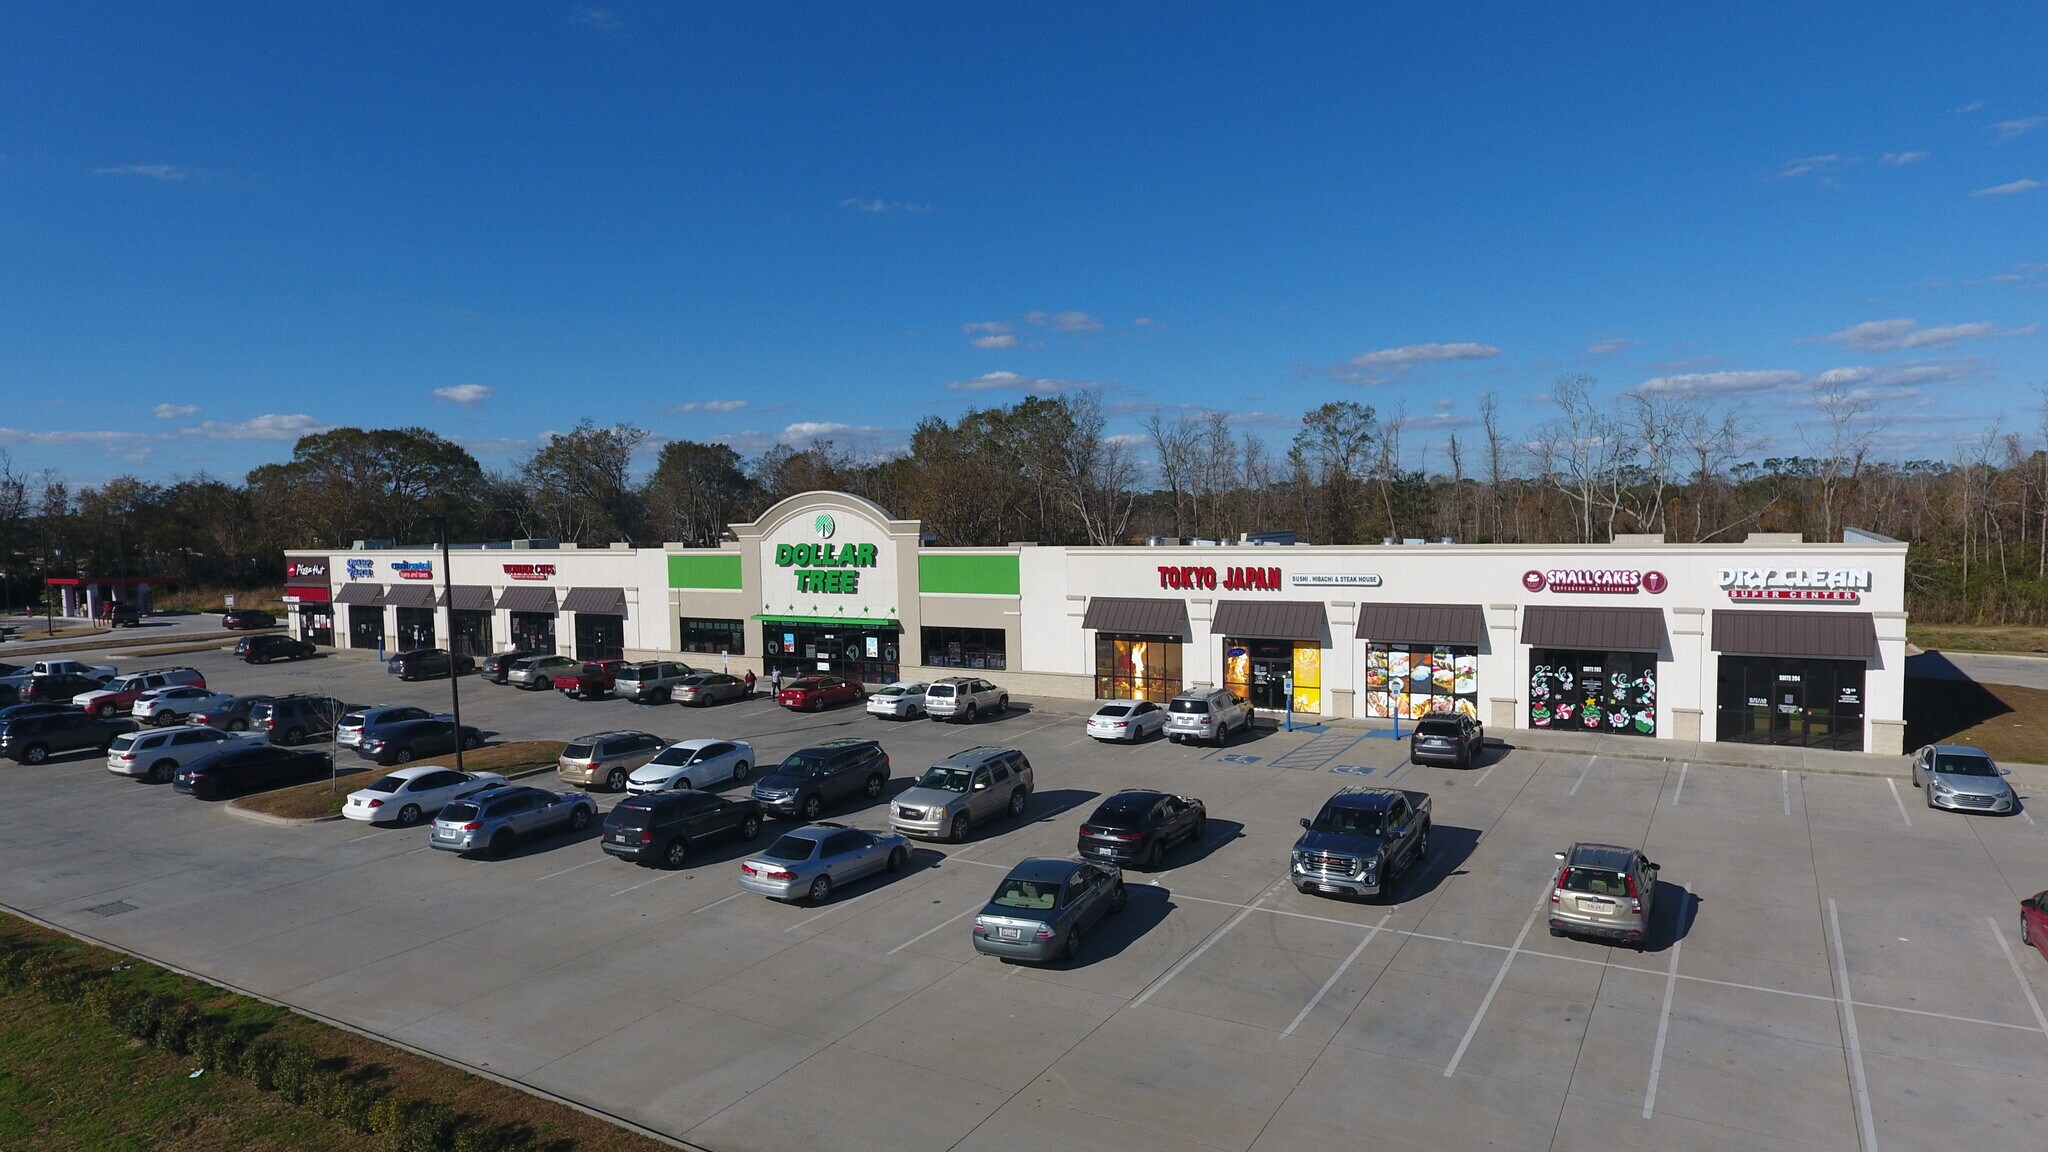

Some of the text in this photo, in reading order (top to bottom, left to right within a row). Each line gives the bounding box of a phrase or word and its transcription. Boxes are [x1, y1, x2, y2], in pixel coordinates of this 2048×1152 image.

[775, 543, 876, 567] DOLLAR
[296, 564, 325, 575] Pizza Hut
[1158, 566, 1281, 591] TOKYO JAPAN
[1717, 567, 1868, 588] DRY CLEAN
[794, 569, 858, 593] TREE
[1731, 590, 1852, 599] SUPER CENTER
[1318, 856, 1341, 865] GMC
